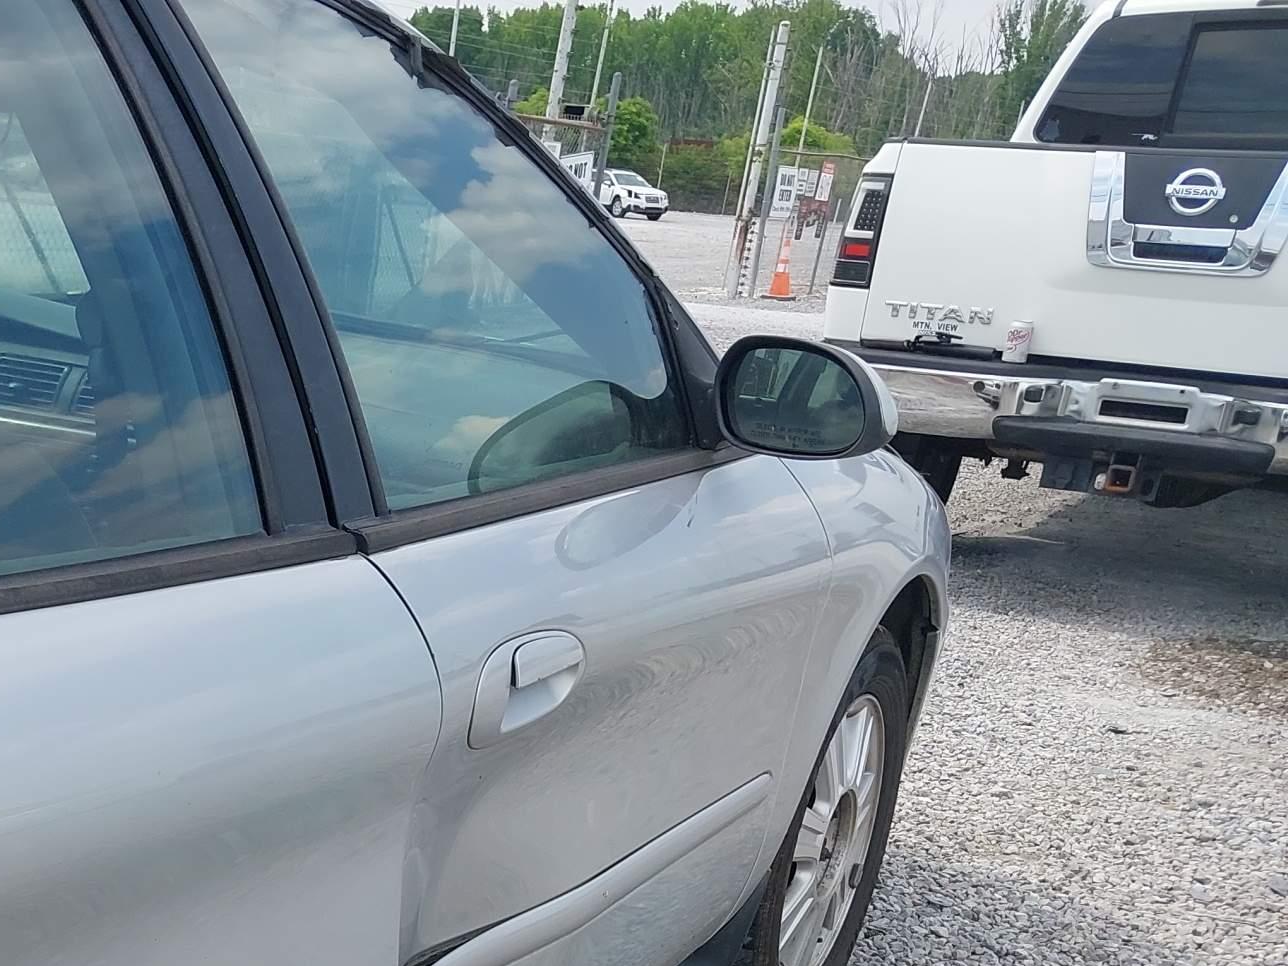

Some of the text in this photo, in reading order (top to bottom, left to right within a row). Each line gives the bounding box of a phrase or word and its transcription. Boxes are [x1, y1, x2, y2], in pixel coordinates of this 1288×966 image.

[1171, 187, 1219, 197] NISSAN
[885, 300, 994, 325] TITAN
[937, 322, 959, 332] VIEW
